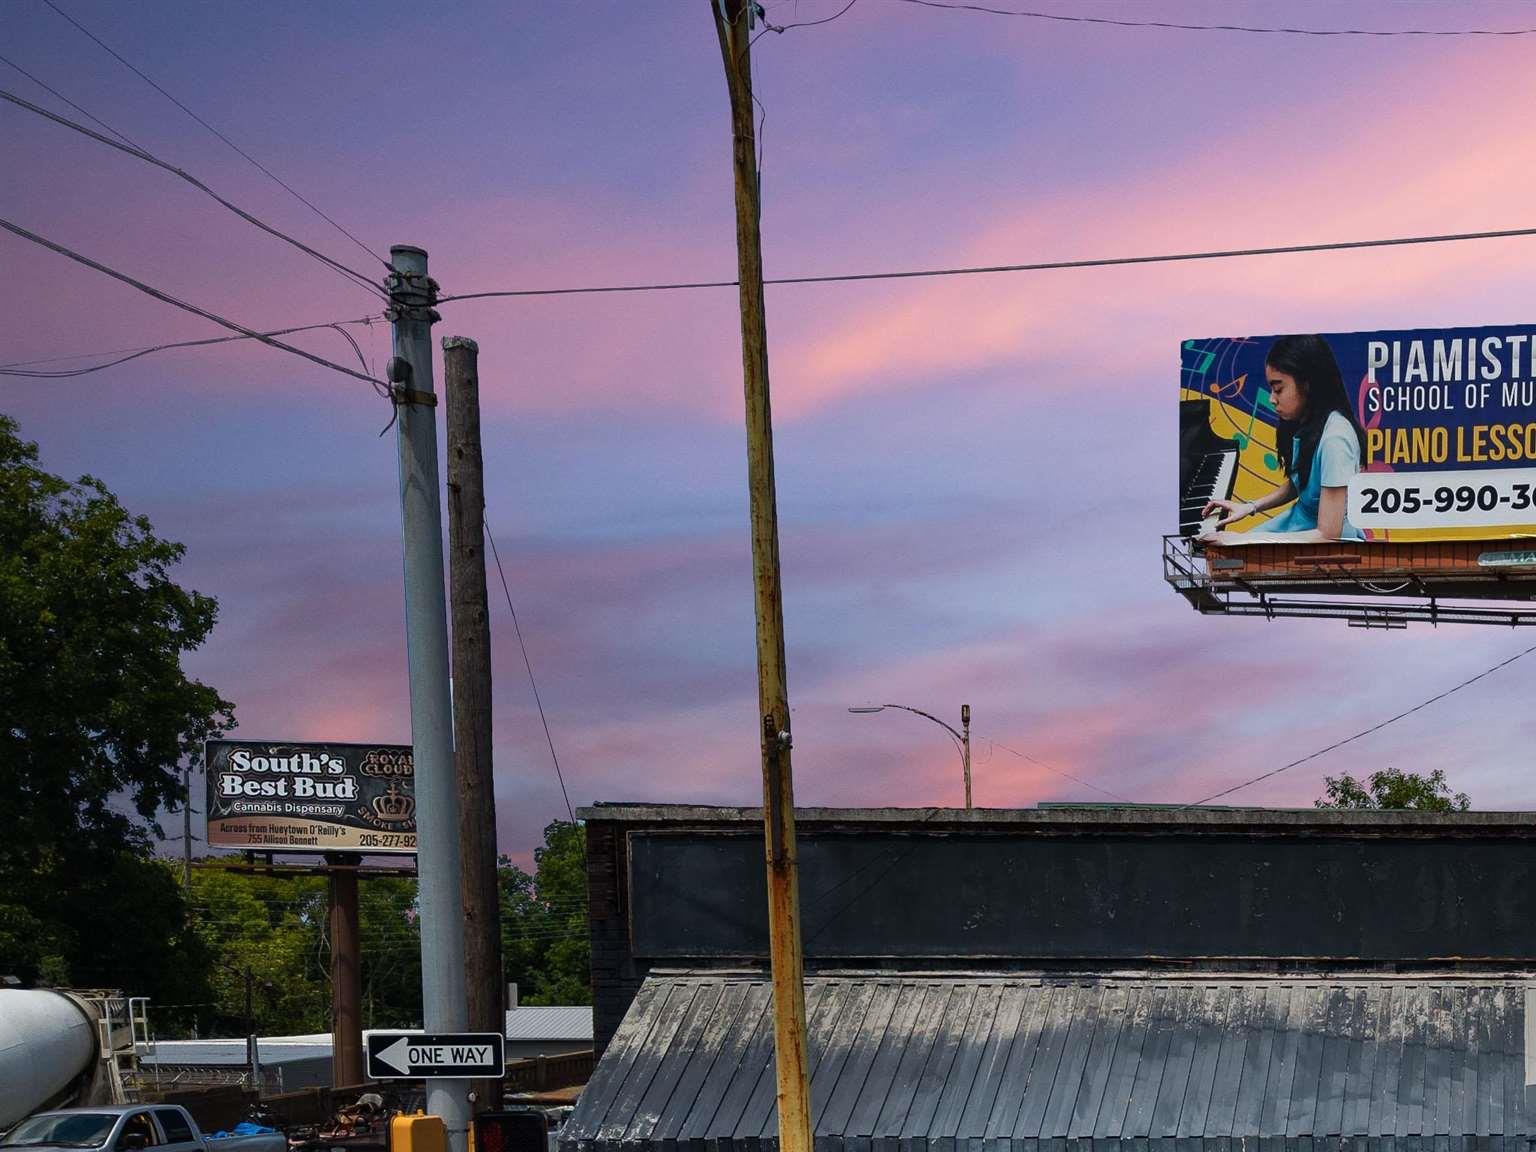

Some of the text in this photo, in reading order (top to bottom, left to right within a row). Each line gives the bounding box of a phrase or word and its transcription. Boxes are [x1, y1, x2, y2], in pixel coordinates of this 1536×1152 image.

[1368, 384, 1454, 412] SCHOOL
[1465, 383, 1491, 409] OF
[1367, 426, 1449, 464] PIANO
[230, 751, 344, 774] South's
[369, 754, 414, 765] ROYAL
[222, 775, 356, 798] Best Bud
[233, 802, 345, 817] Cannabis Dispensary
[269, 824, 308, 836] Hueytown
[359, 834, 417, 847] 205-277-92
[408, 1047, 488, 1064] ONE WAY
